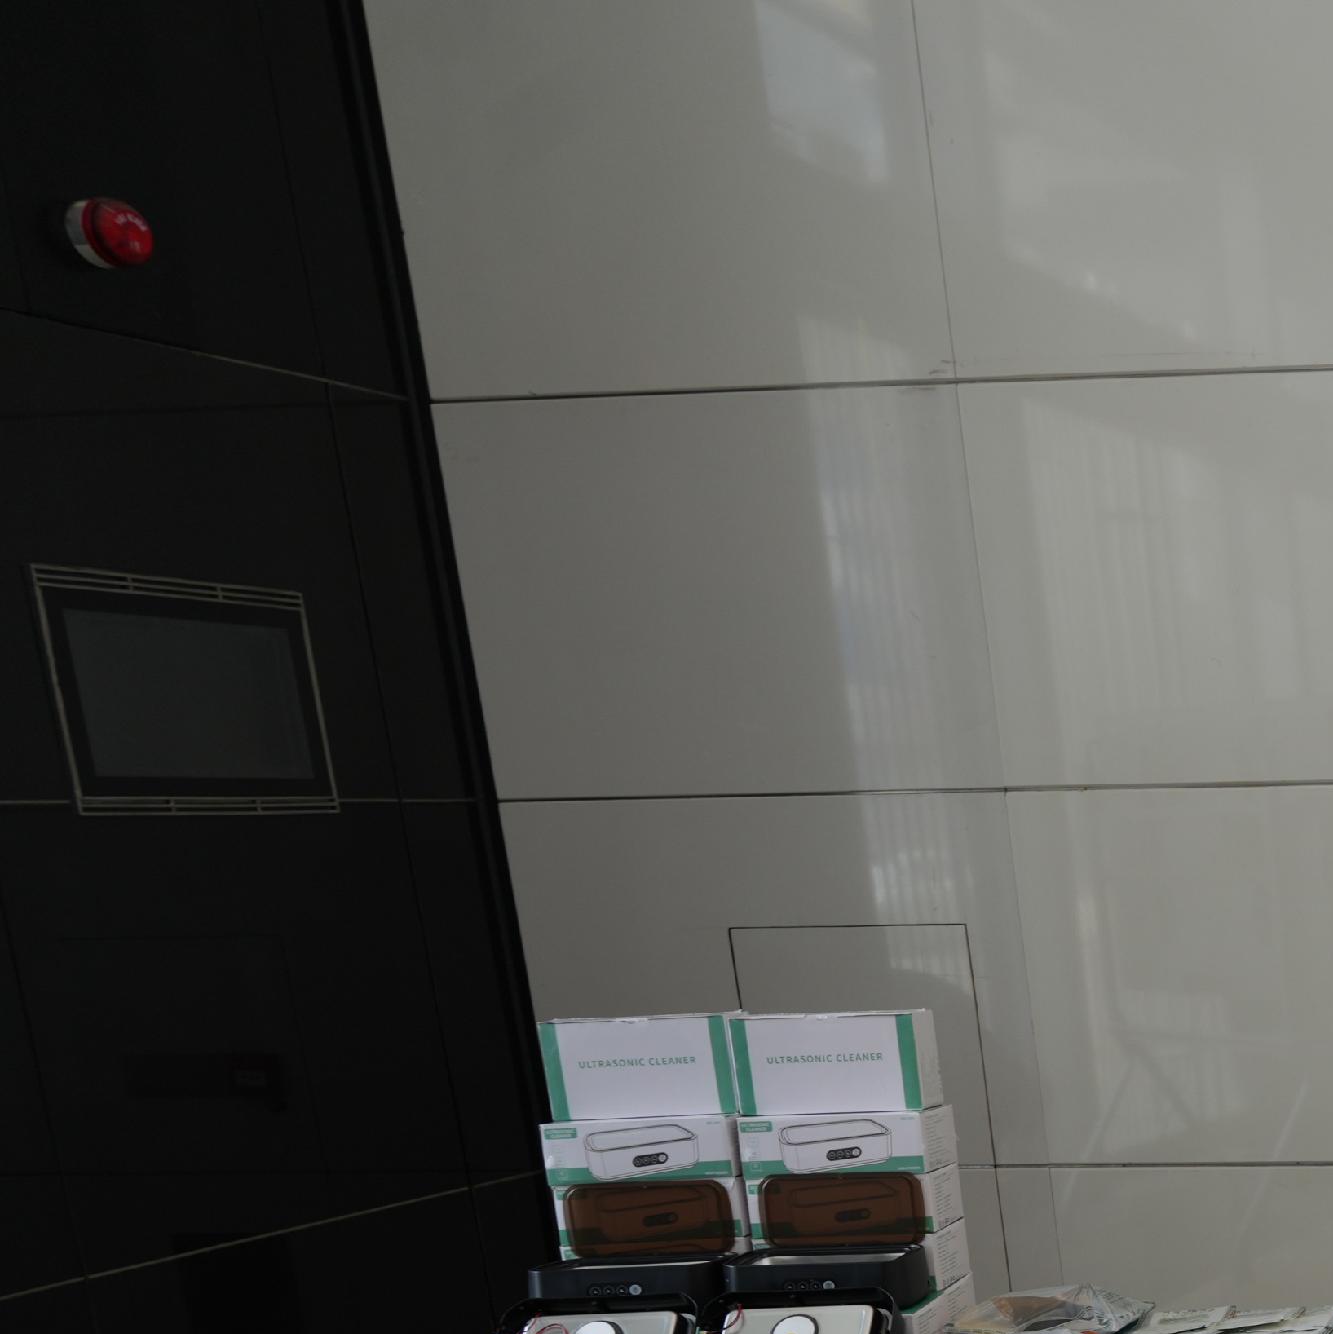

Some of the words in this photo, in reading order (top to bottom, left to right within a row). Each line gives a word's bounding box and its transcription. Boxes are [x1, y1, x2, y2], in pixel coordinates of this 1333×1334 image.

[577, 1057, 646, 1069] ULTRASONIC
[647, 1055, 697, 1067] CLEANER
[765, 1053, 833, 1064] ULTRASONIC
[835, 1051, 884, 1063] CLEANER
